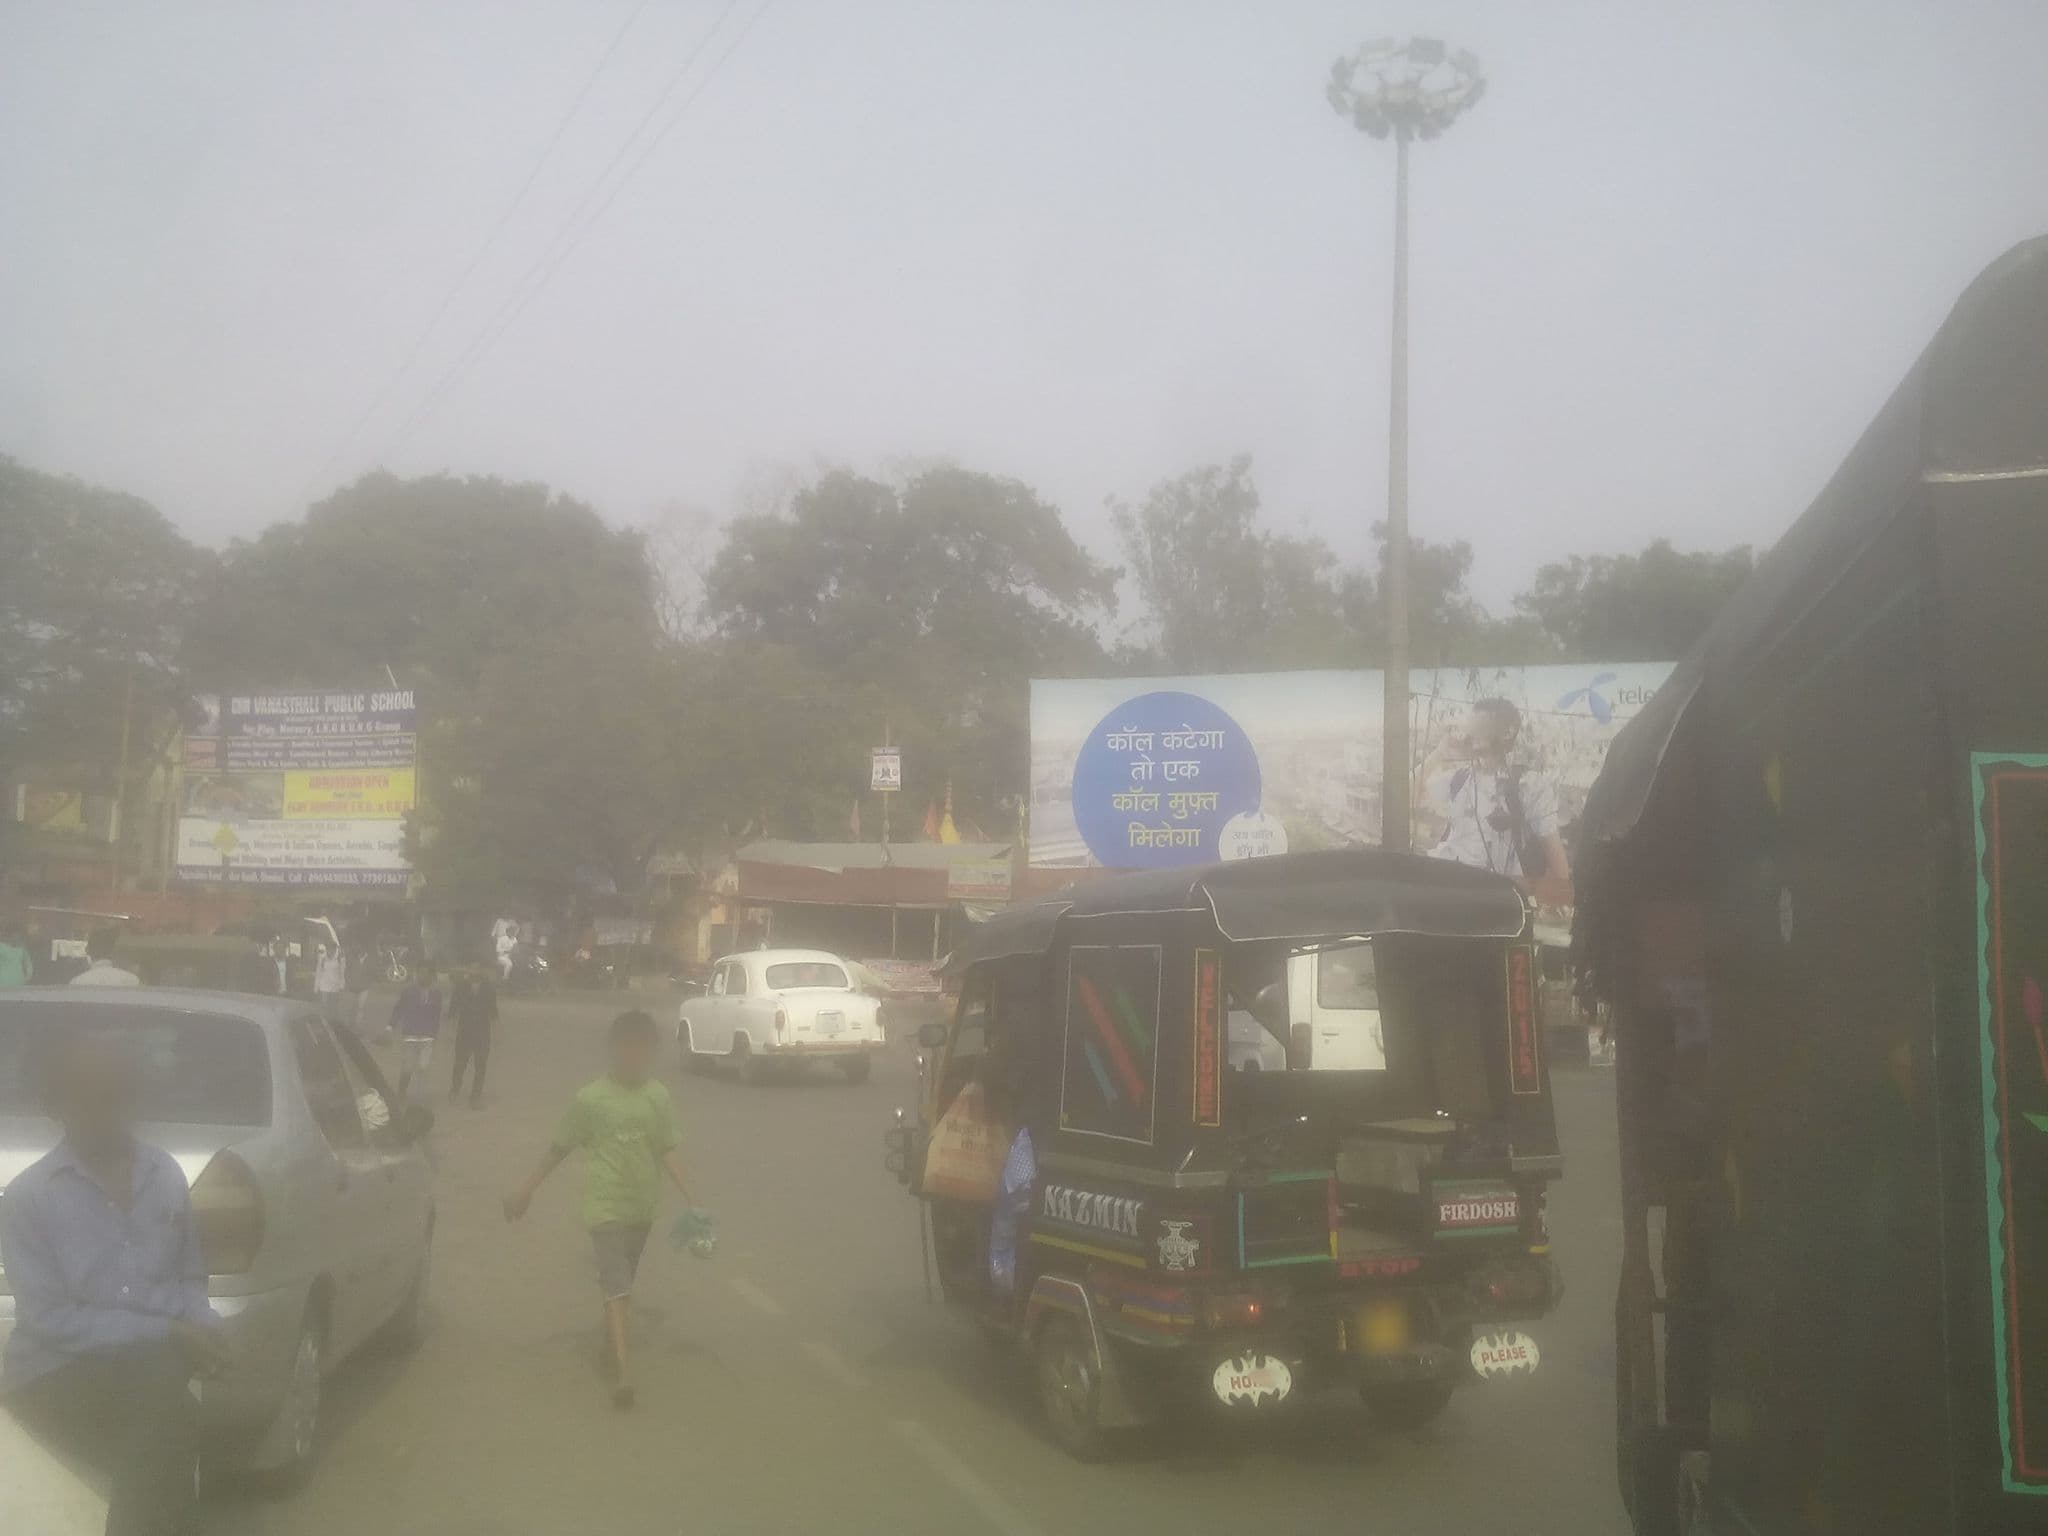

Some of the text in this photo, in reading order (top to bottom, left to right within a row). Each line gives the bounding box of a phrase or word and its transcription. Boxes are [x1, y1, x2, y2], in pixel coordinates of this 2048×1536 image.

[325, 694, 365, 712] PUBLIC
[370, 691, 416, 712] SCHOOL
[1107, 723, 1225, 751] कॉल कटेगा
[1129, 754, 1201, 782] तो एक
[1112, 786, 1161, 812] कॉल
[1127, 820, 1202, 849] मिलेगा
[1043, 1184, 1145, 1236] NAZMIN
[1439, 1201, 1517, 1222] FIRDOSH
[1481, 1346, 1527, 1364] PLEASE
